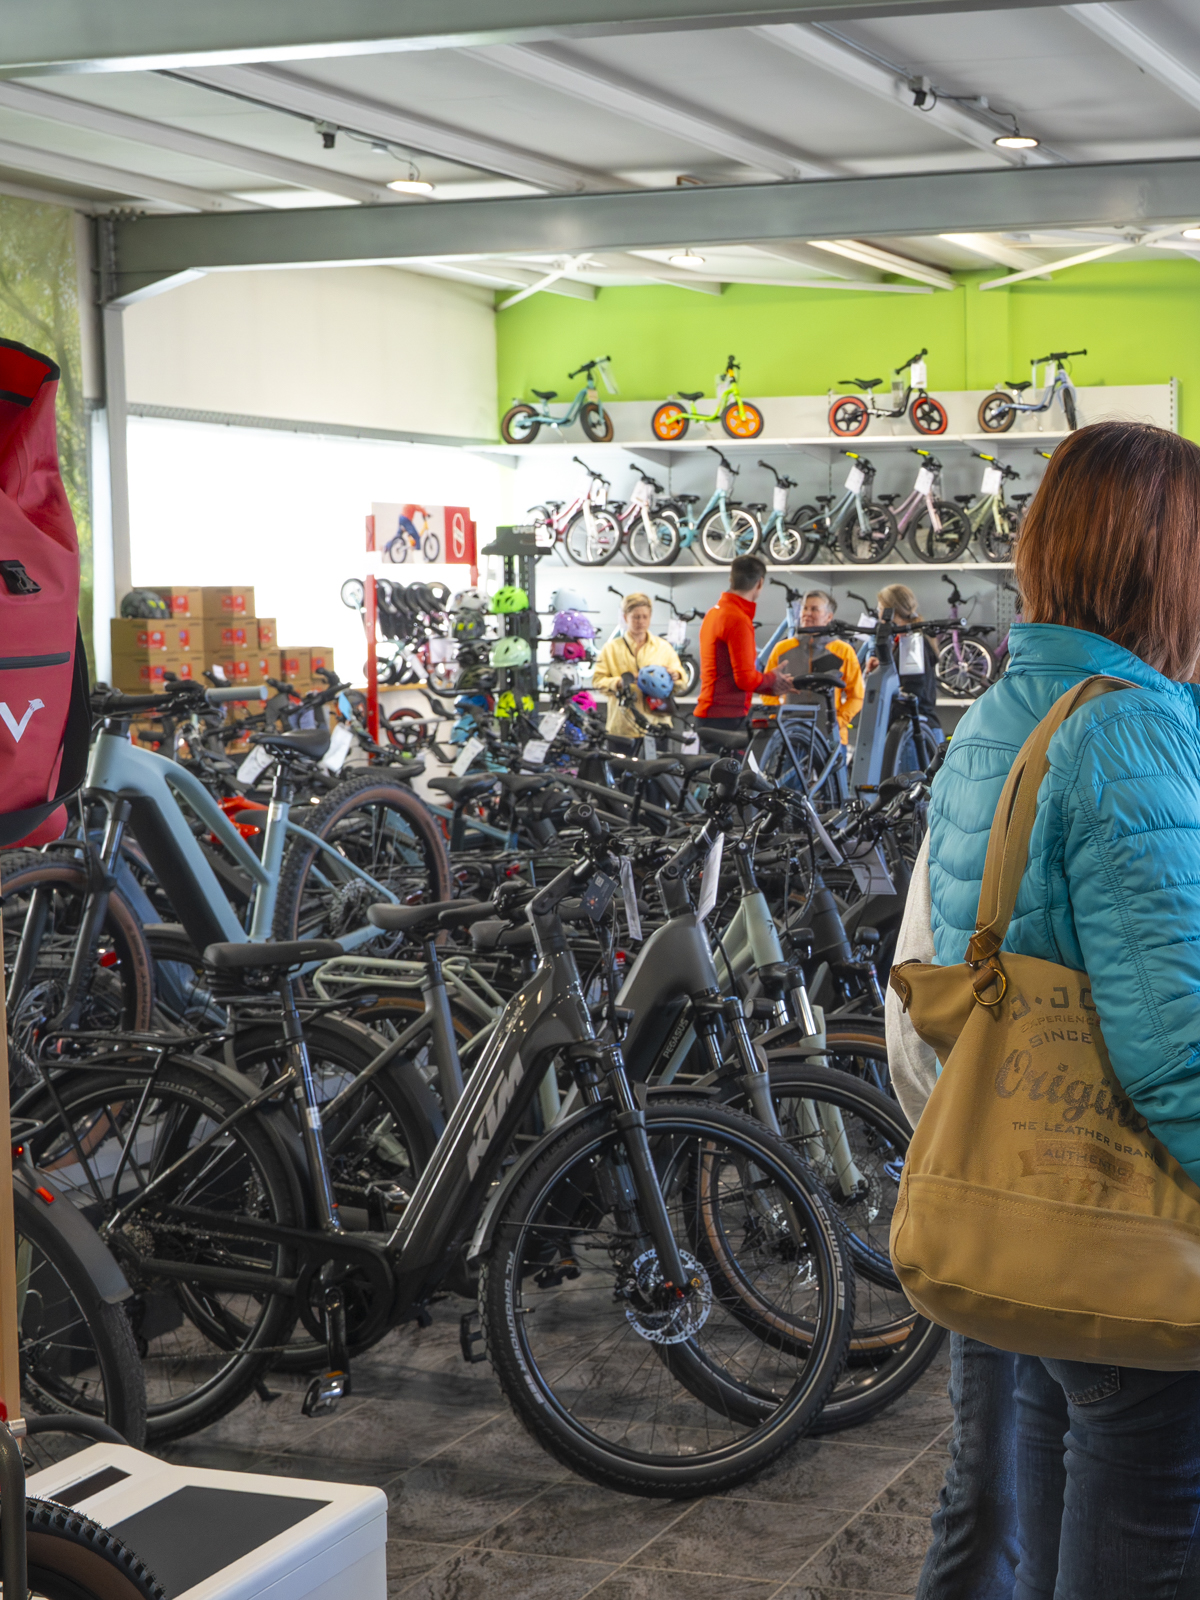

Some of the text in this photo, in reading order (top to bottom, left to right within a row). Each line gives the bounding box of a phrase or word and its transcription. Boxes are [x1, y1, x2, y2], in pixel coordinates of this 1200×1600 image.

[662, 1018, 689, 1060] PEGASUS
[1021, 1014, 1100, 1033] EXPERIENC
[1029, 1030, 1093, 1049] SINCE
[467, 1051, 524, 1181] KTM
[1012, 1121, 1161, 1167] THE LEATHER BRAND
[1043, 1148, 1130, 1176] AUTHENTIC
[811, 1193, 846, 1310] SCHWALBE
